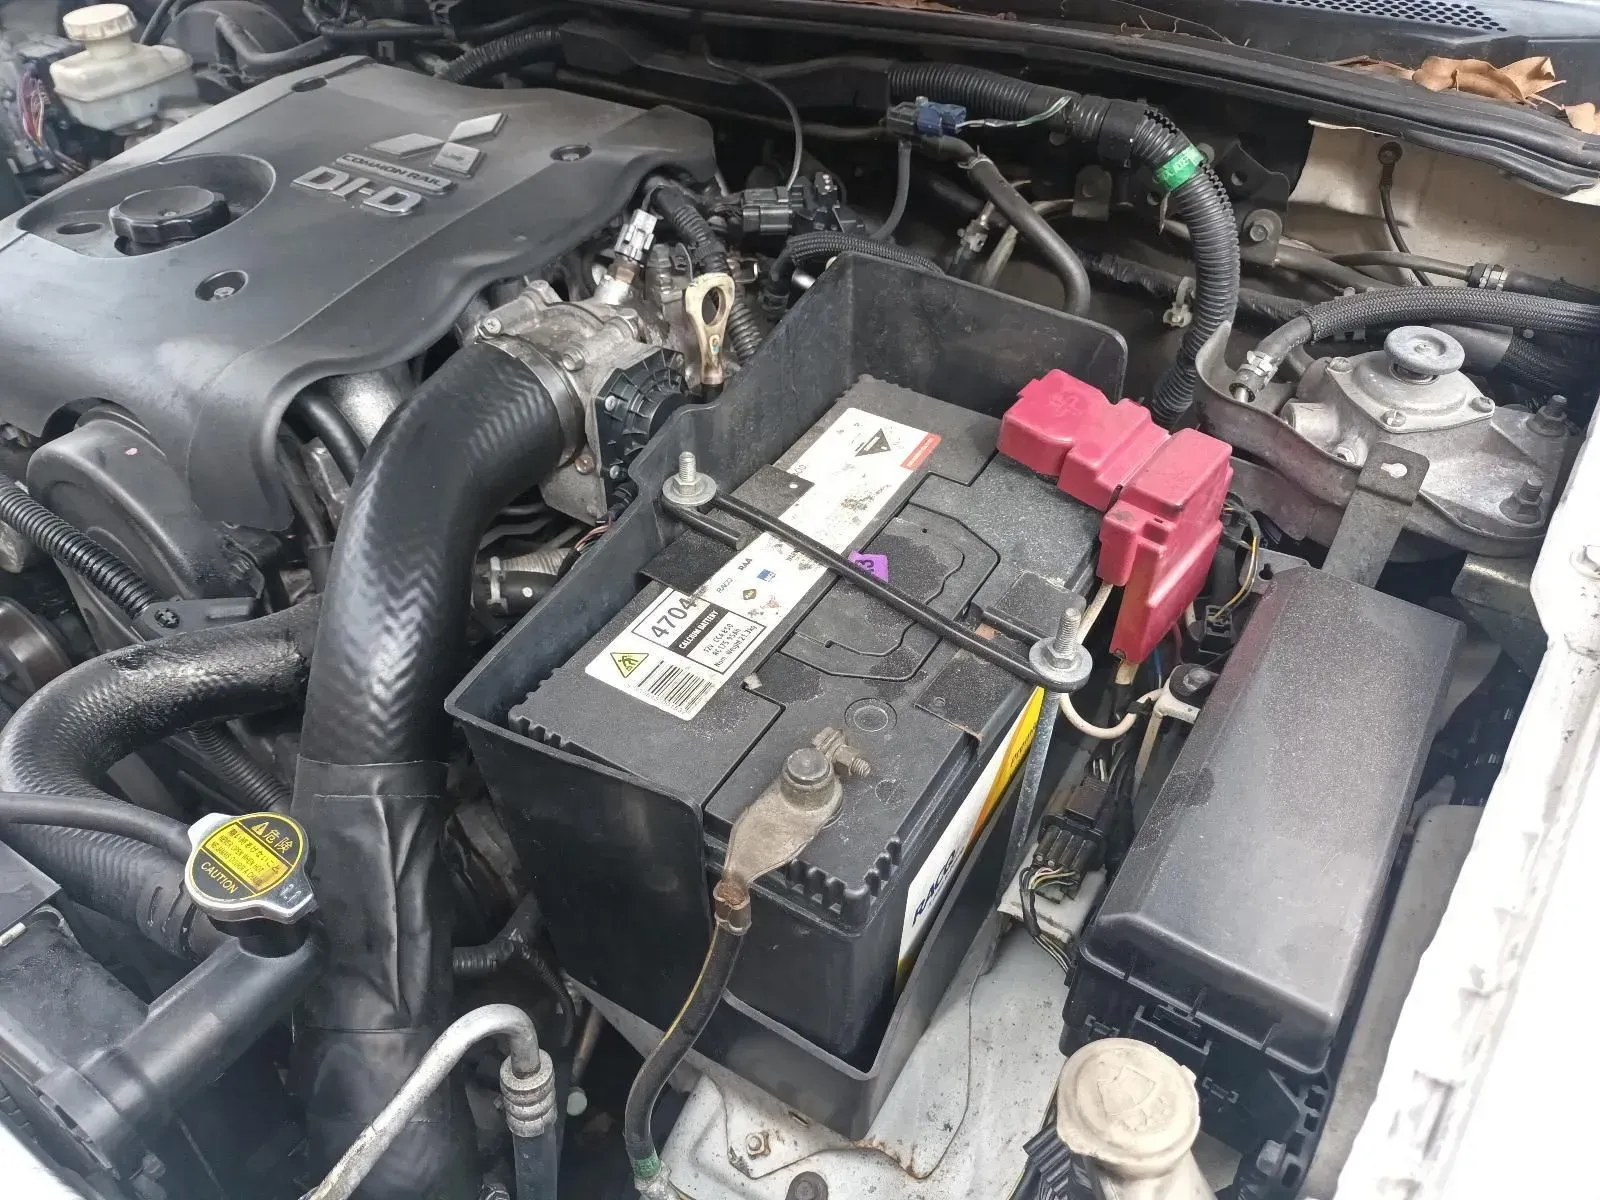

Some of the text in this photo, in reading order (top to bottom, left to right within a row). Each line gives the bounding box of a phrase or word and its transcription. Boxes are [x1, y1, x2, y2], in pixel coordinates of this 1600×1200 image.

[292, 166, 422, 213] DI-D
[342, 154, 441, 186] COMMON RAIL
[651, 598, 697, 637] 4704
[679, 610, 719, 649] CALCIUM BATTERY
[201, 862, 239, 894] CAUTION
[912, 850, 956, 927] RACQ
